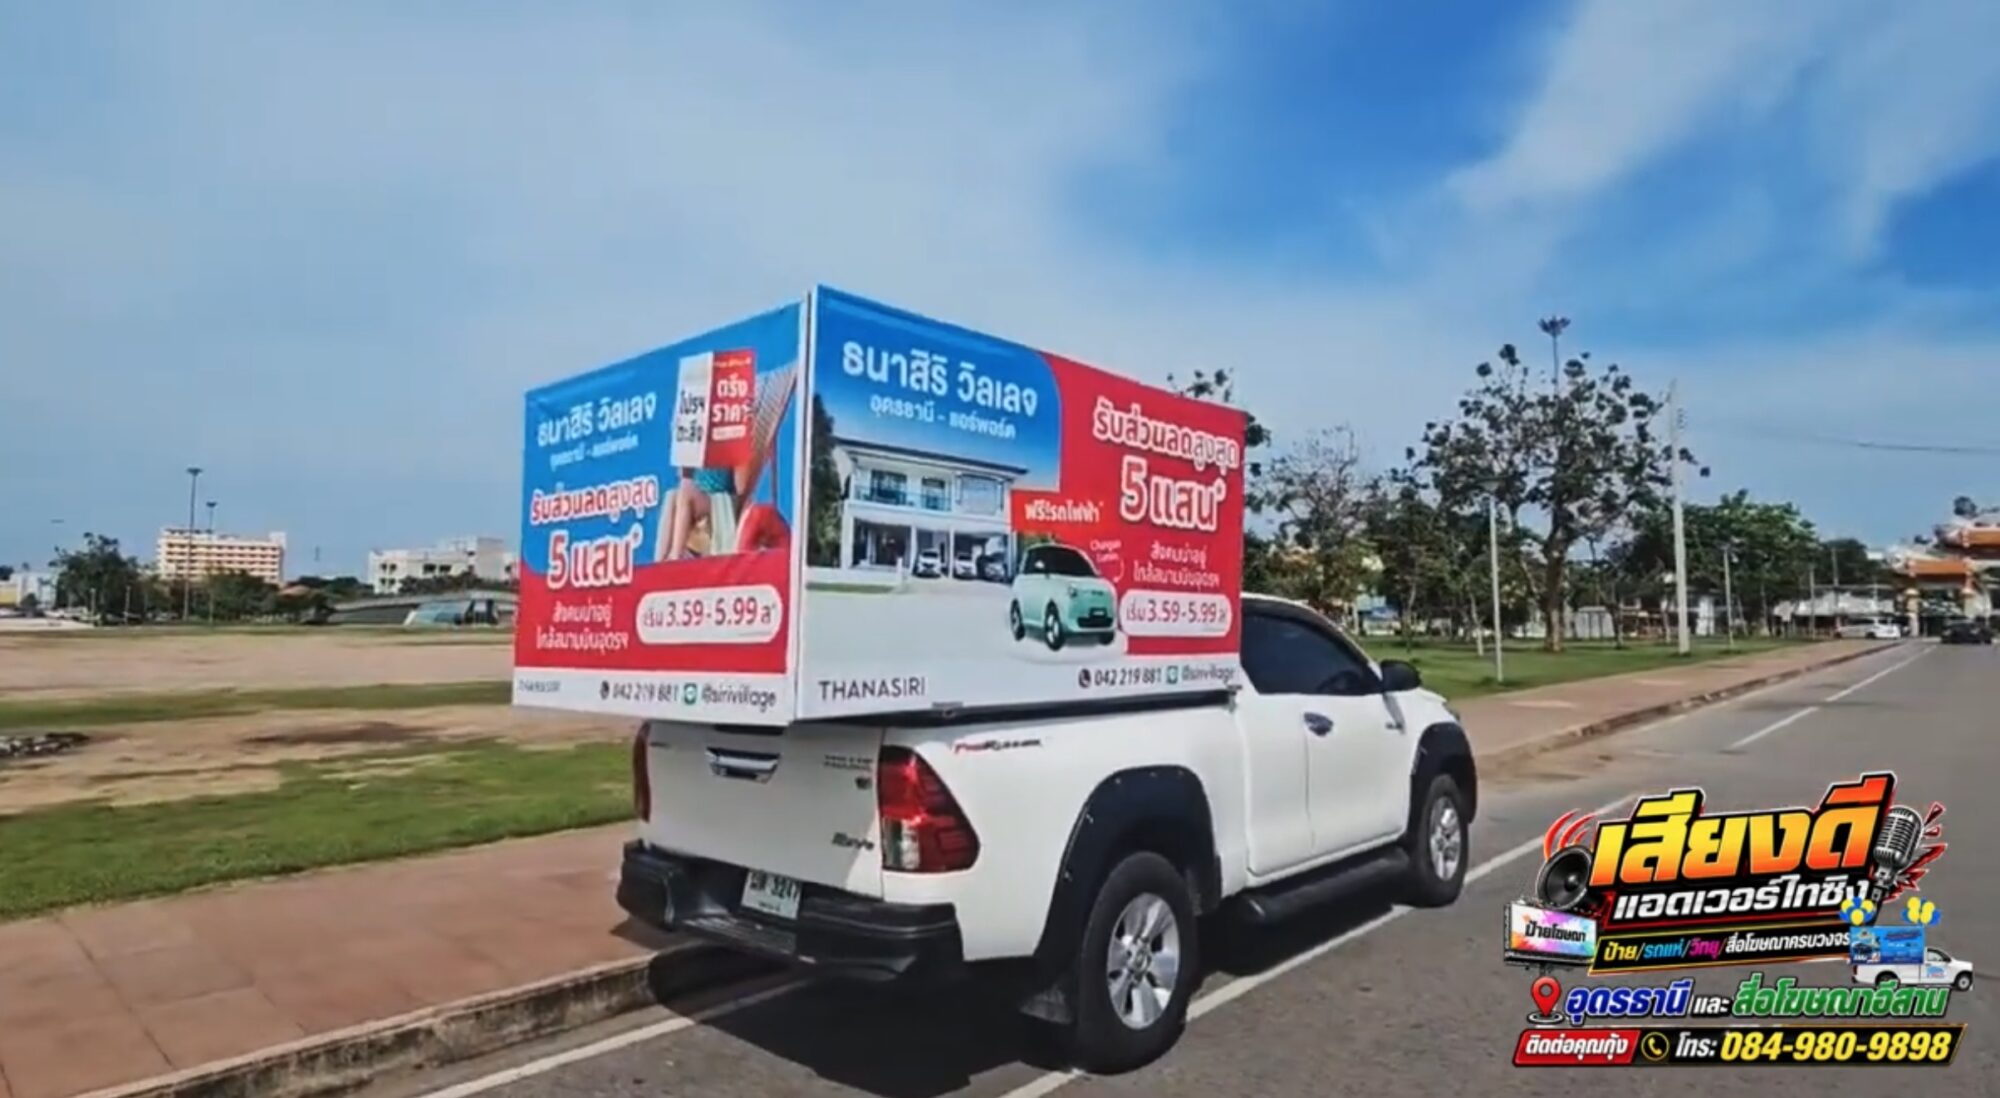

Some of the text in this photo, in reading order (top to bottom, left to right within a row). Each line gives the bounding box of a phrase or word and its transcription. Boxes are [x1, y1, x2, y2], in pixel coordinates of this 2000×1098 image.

[842, 340, 1039, 418] ธนาสิริ วิลเลจ
[536, 392, 657, 446] ธนาสิริ วิลเลจ
[1093, 396, 1239, 476] รับส่วนลดสูงสุด
[531, 475, 659, 526] รับส่วนลดสูงสุด
[819, 677, 926, 700] THANASIRI
